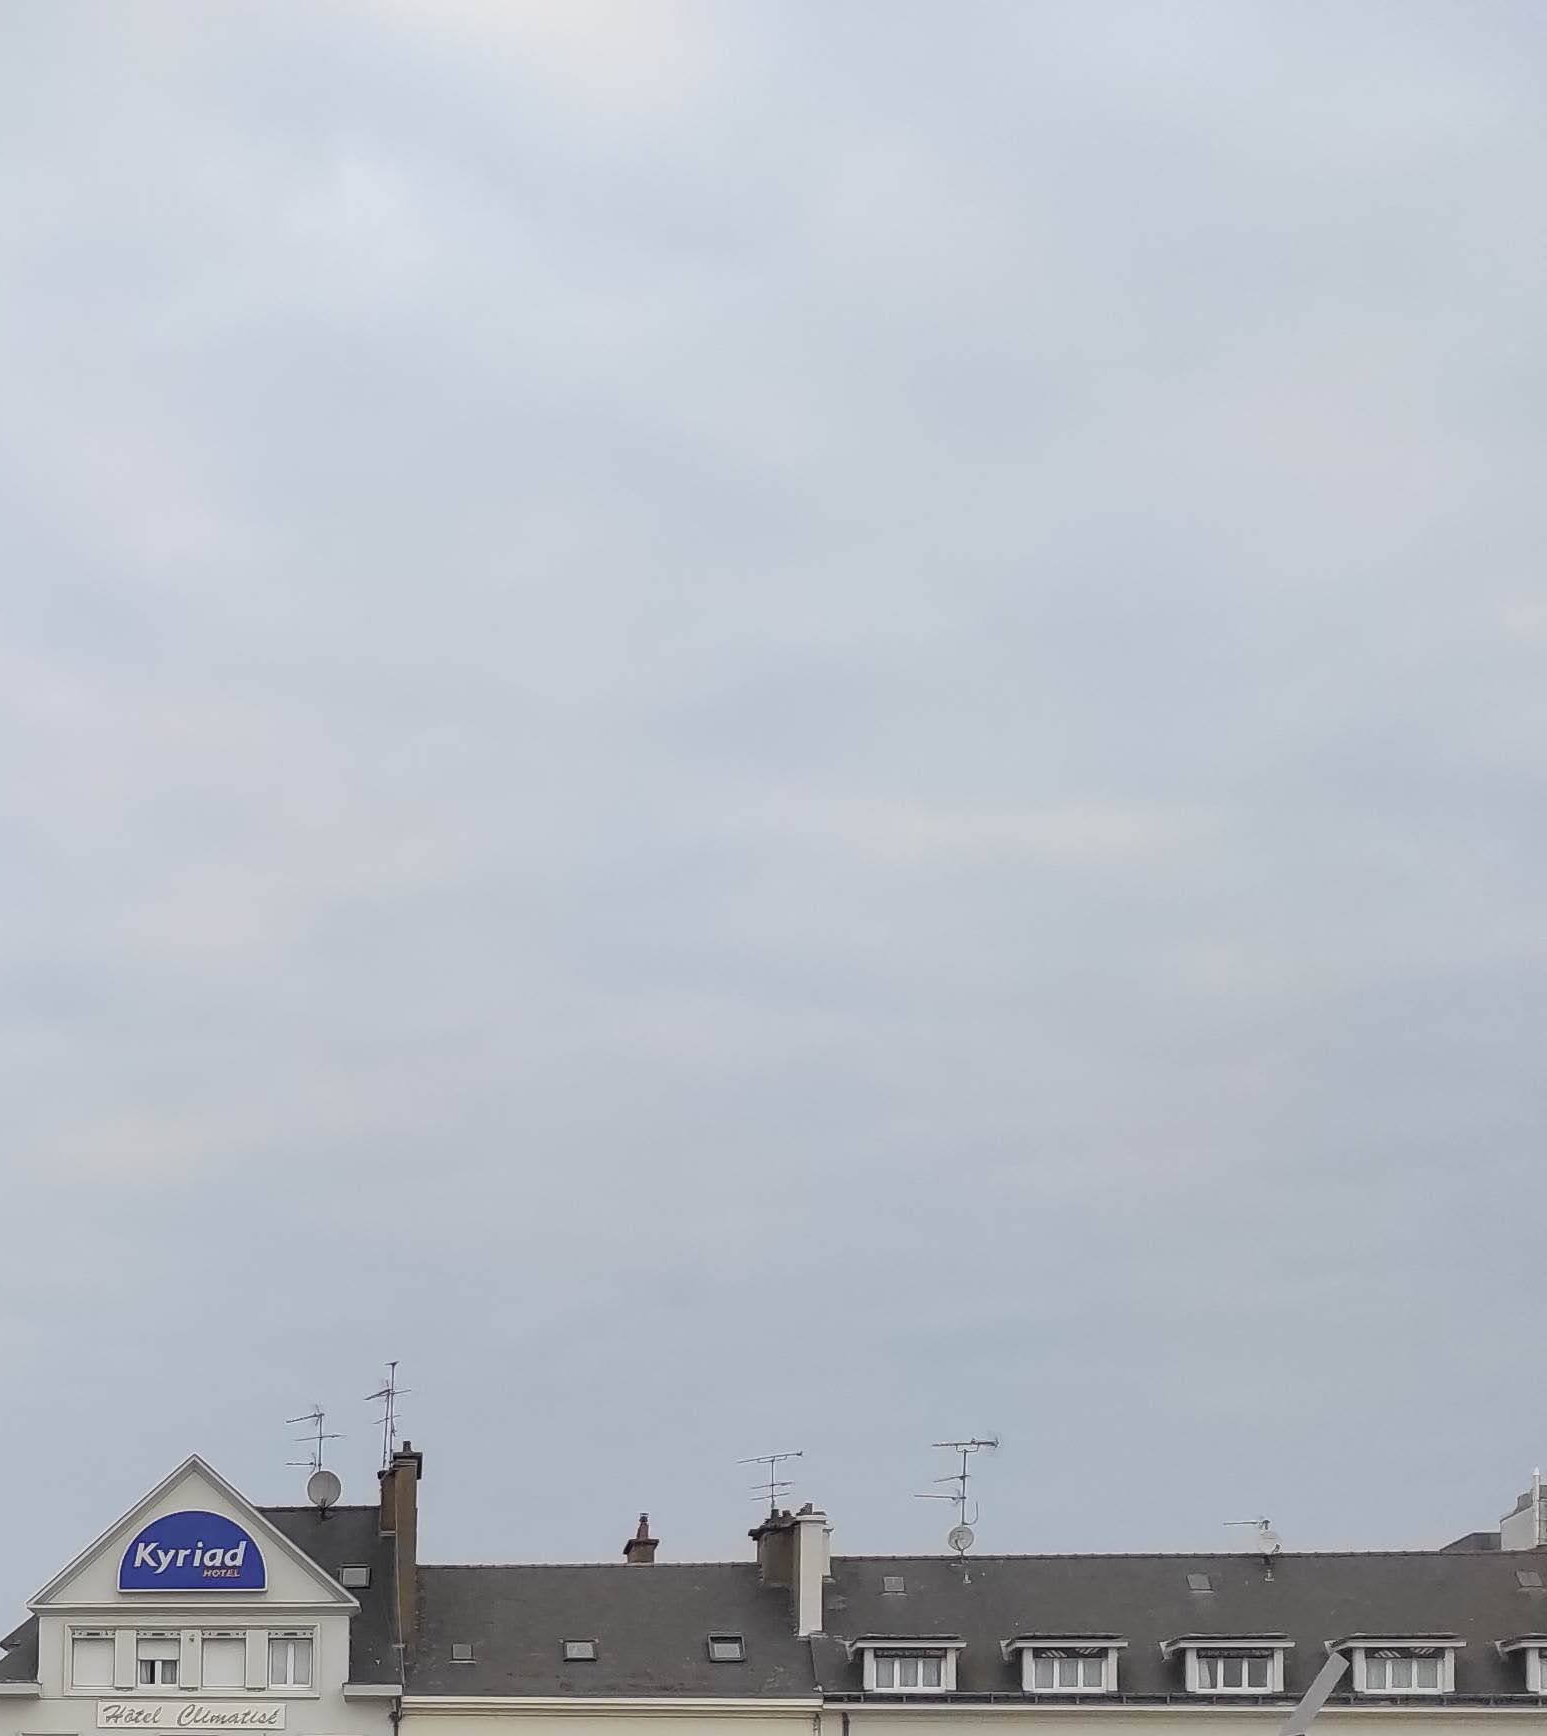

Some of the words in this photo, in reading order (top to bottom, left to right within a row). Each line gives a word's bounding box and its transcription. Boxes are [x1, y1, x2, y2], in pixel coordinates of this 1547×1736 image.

[133, 1540, 248, 1574] Kyriad
[202, 1568, 241, 1578] HOTEL
[103, 1704, 163, 1724] Hôtel
